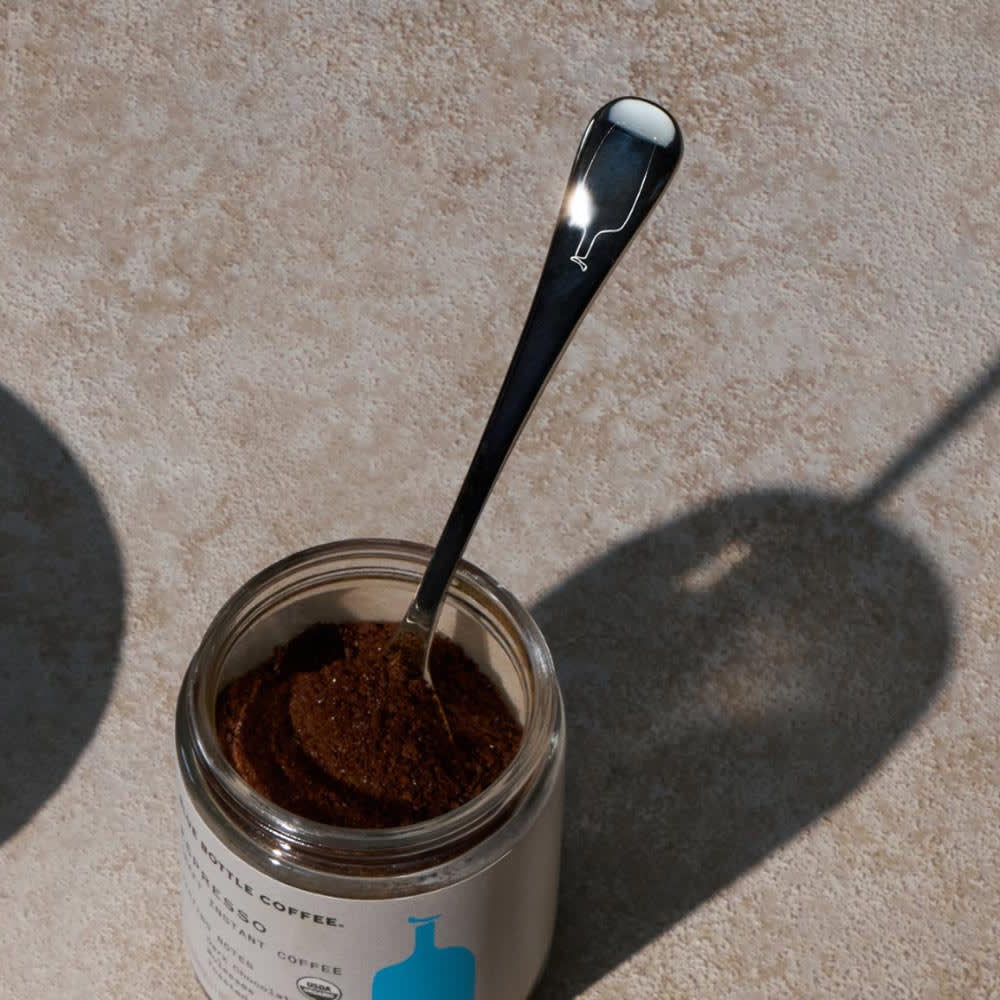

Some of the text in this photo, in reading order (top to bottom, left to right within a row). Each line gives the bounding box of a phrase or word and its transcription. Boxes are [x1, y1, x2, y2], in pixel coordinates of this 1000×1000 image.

[200, 840, 254, 896] BOTTLE
[259, 894, 338, 928] COFFEE
[276, 950, 343, 976] COFFEE
